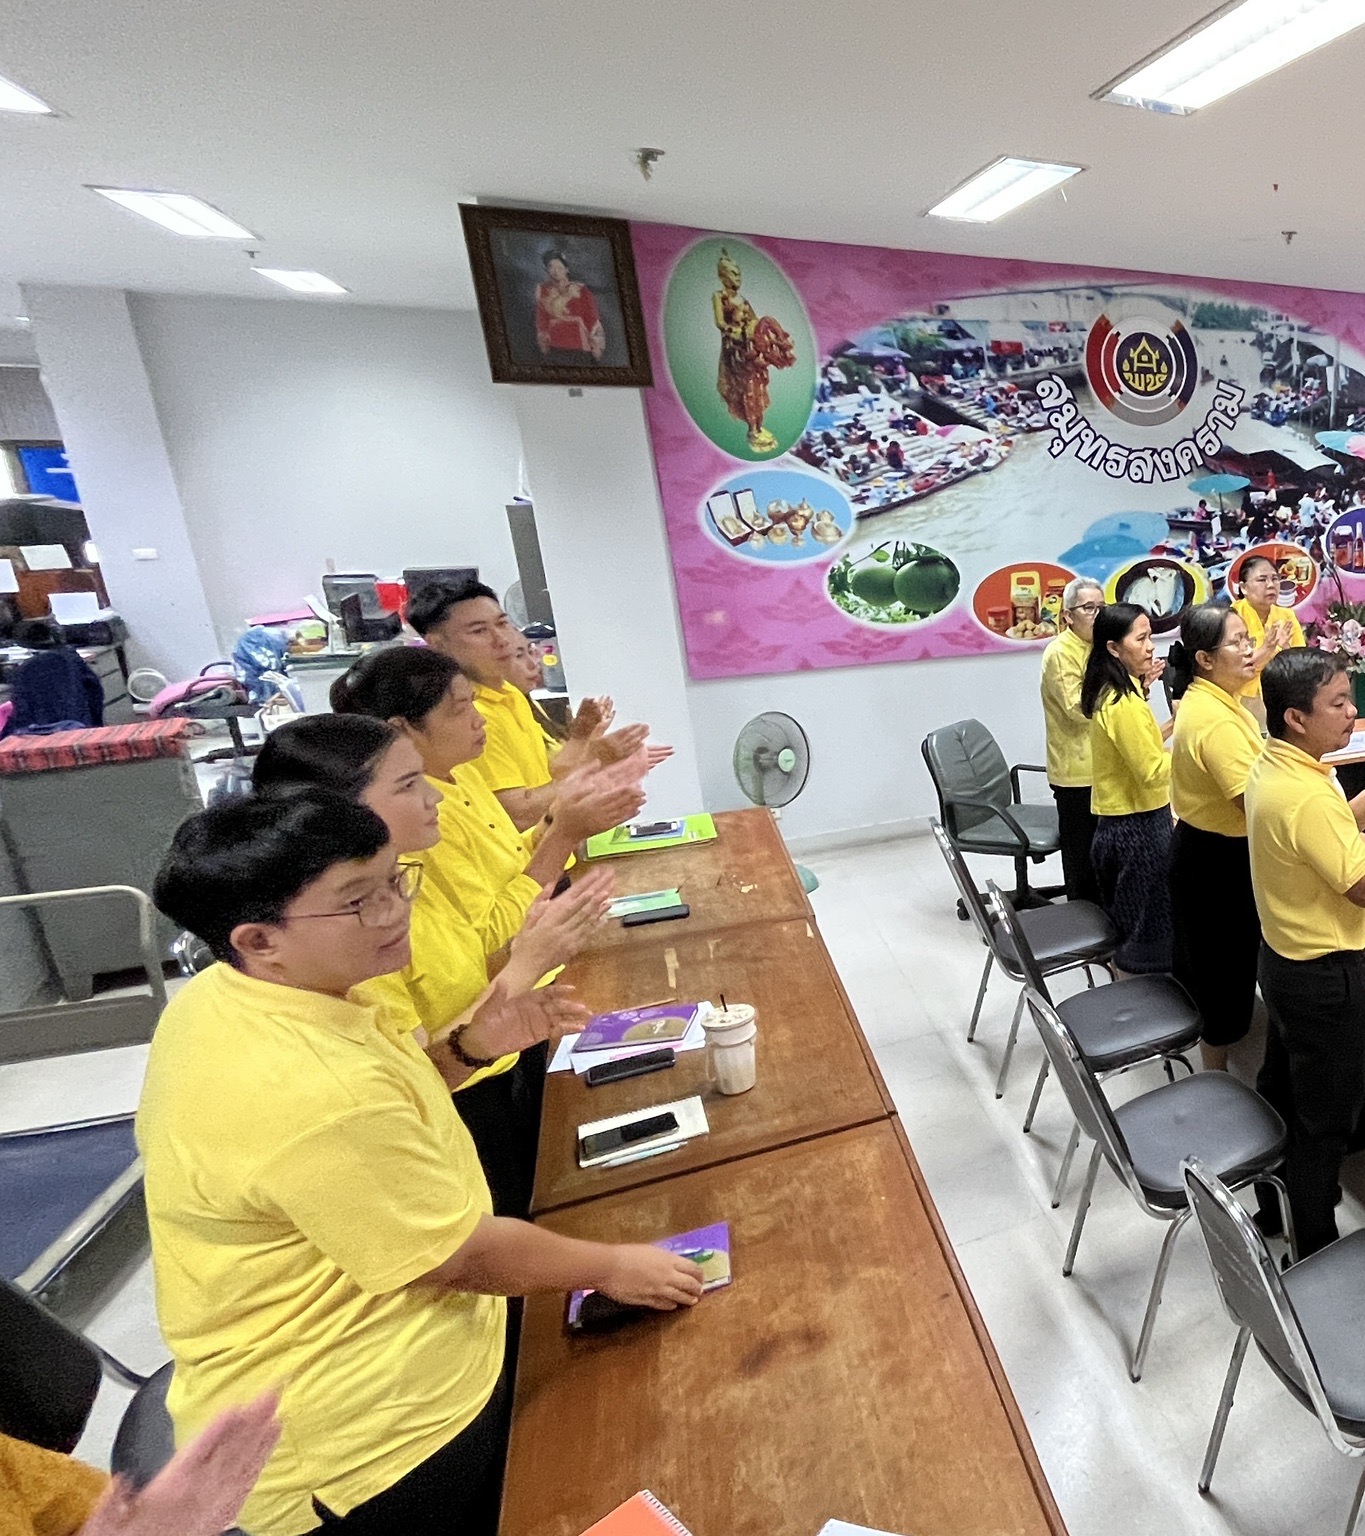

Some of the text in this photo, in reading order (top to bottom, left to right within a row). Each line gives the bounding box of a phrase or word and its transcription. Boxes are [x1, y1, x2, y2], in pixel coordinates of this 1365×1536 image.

[1036, 373, 1245, 483] สมุทรสงคราม
